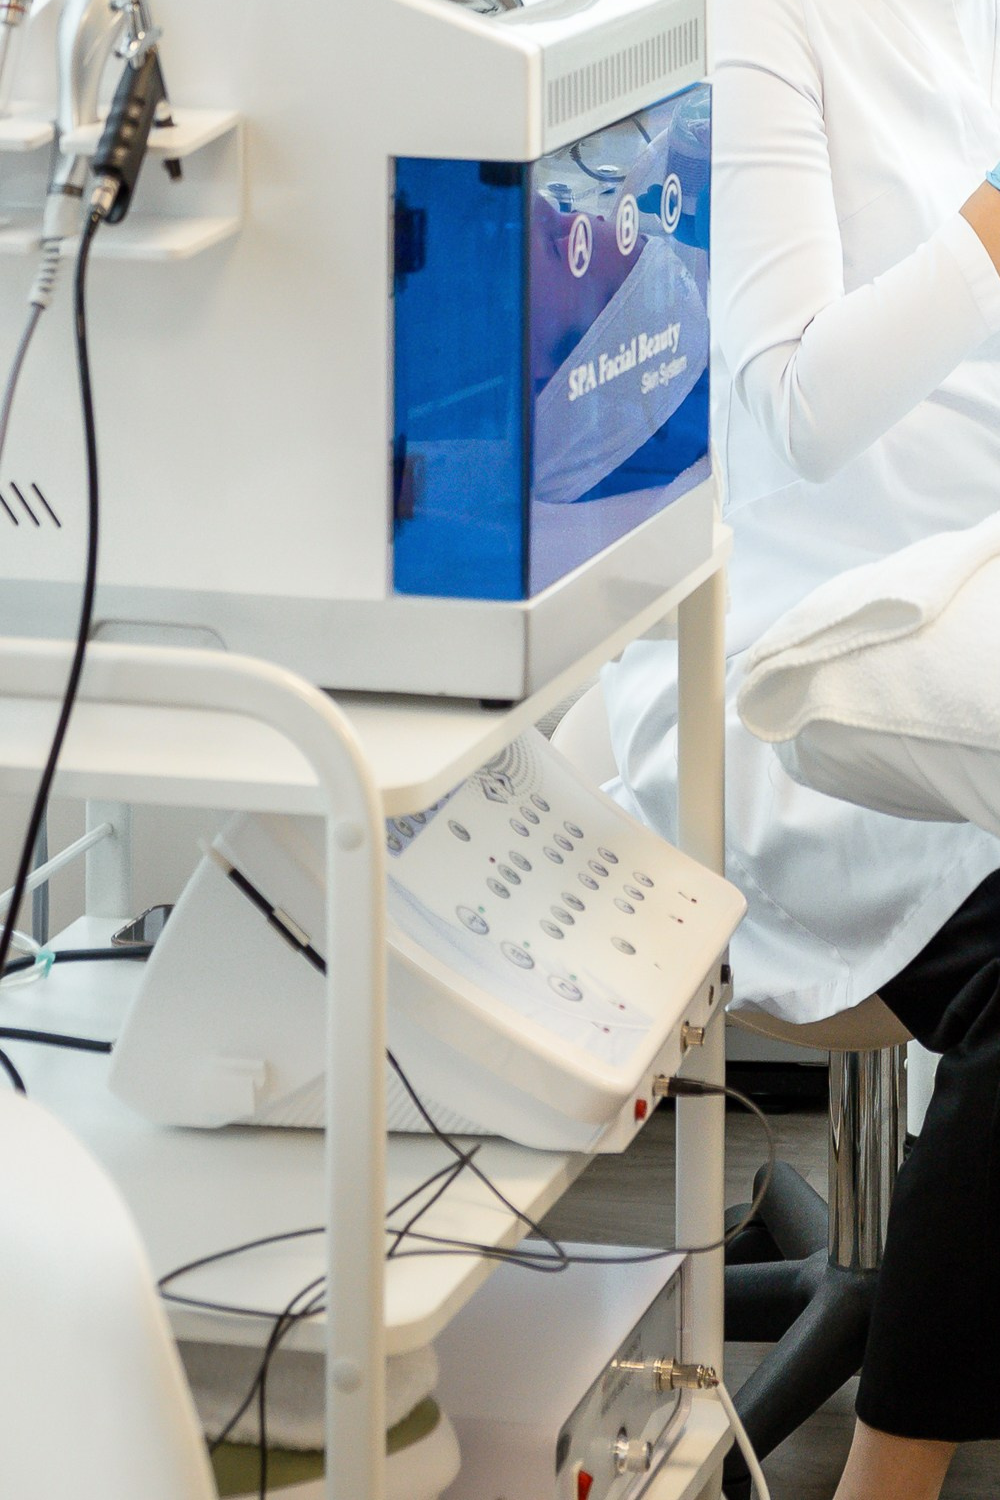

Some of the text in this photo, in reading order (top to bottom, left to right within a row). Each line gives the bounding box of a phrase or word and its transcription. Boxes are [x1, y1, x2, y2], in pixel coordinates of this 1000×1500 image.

[568, 322, 681, 402] SPA Facial Beauty
